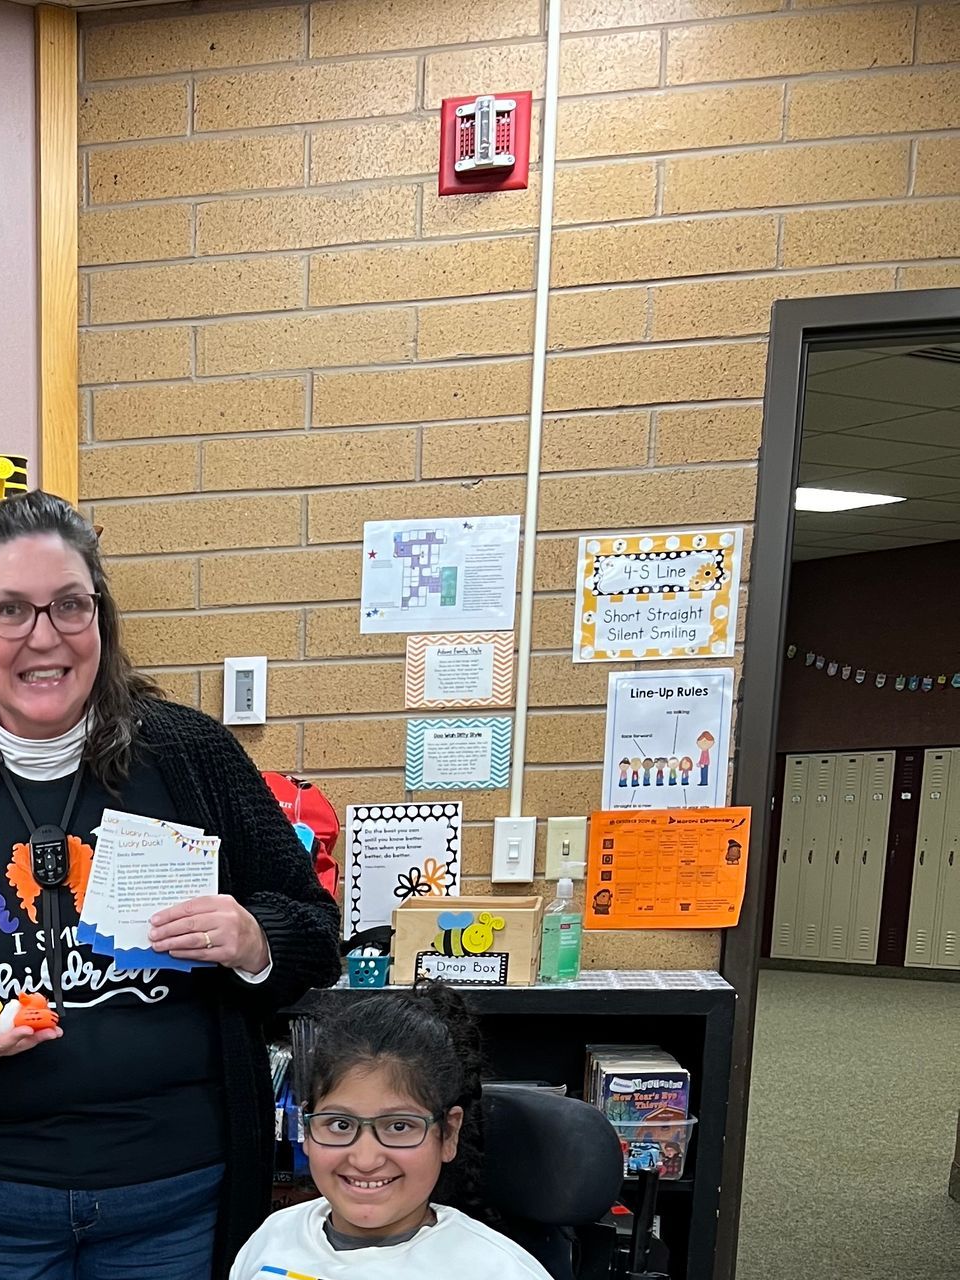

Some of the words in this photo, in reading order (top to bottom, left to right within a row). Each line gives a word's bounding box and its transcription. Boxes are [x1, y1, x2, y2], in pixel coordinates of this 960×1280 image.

[624, 564, 650, 580] 4-S
[657, 565, 686, 579] Line
[603, 609, 641, 624] Short
[647, 606, 704, 623] Straight
[607, 627, 644, 641] Silent
[650, 626, 696, 641] Smiling
[630, 687, 674, 699] Line-Up
[677, 686, 709, 697] Rules
[119, 840, 140, 849] Lucky
[11, 932, 26, 956] I
[436, 961, 467, 974] Drop
[473, 962, 496, 973] Box
[613, 1093, 632, 1102] New
[633, 1092, 660, 1101] Year's
